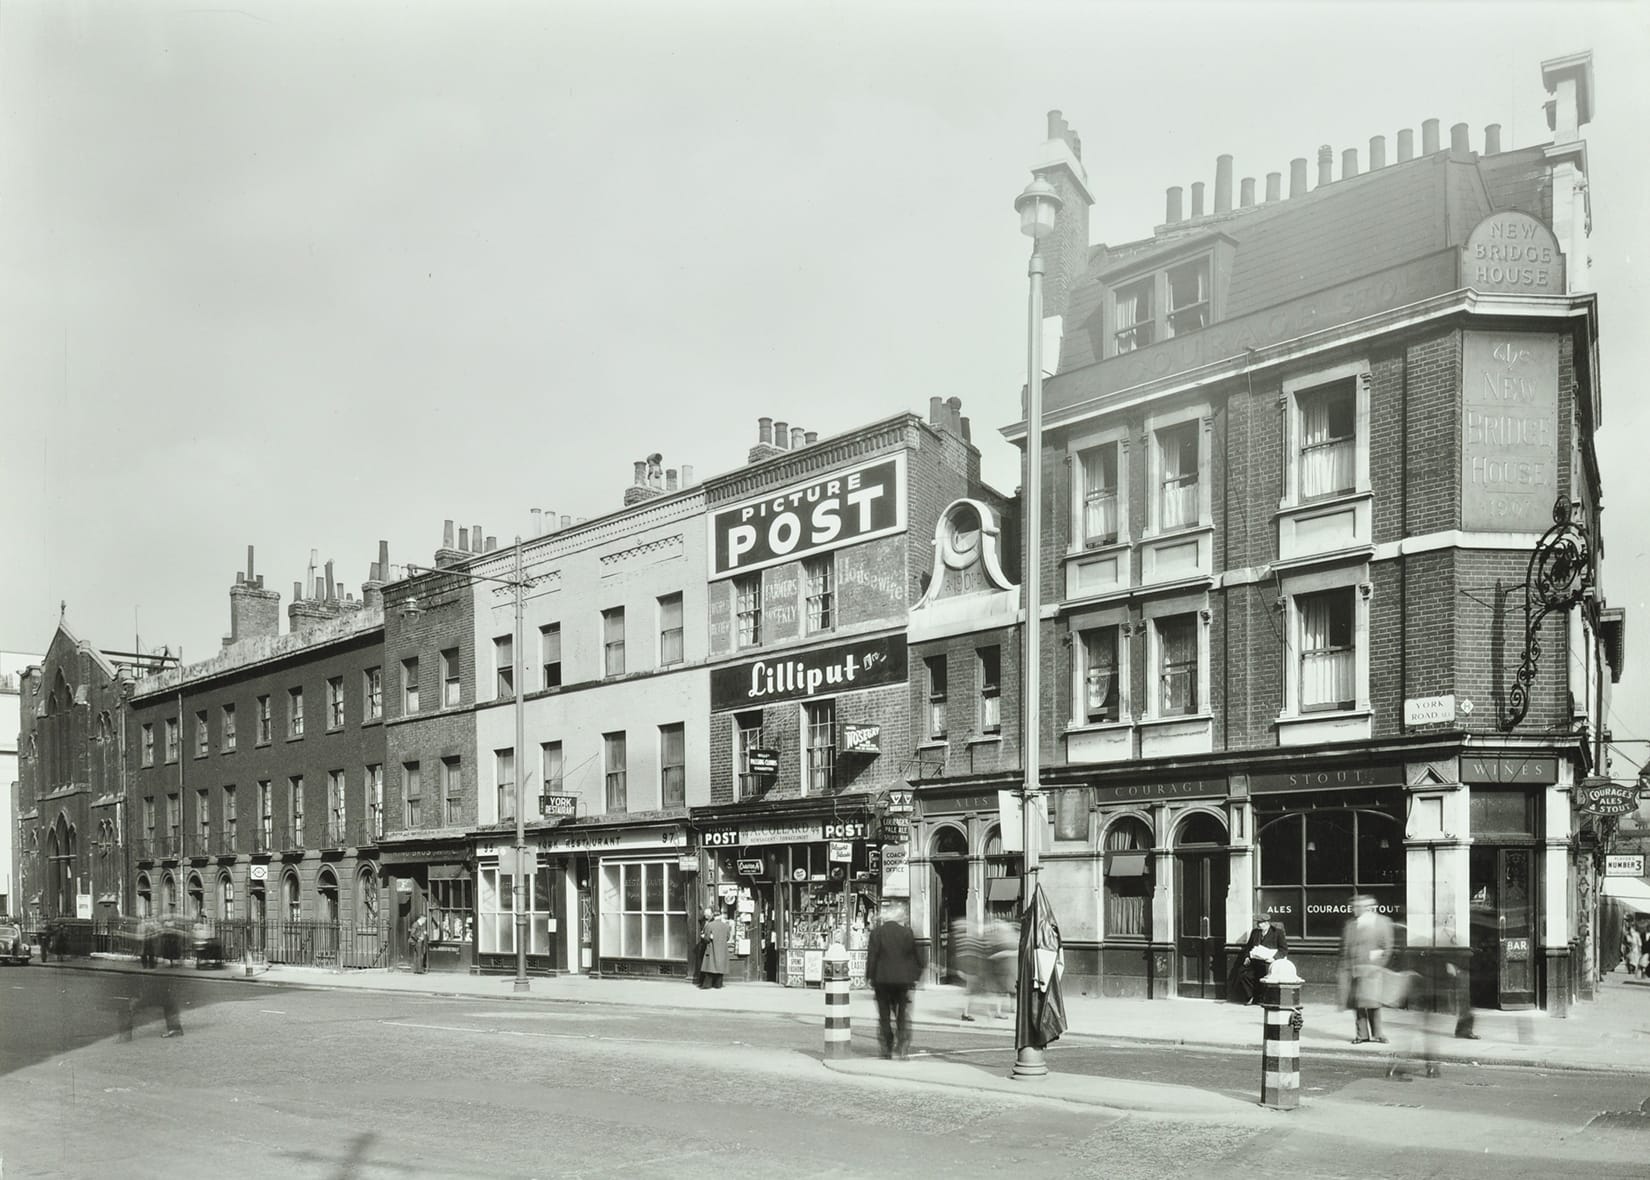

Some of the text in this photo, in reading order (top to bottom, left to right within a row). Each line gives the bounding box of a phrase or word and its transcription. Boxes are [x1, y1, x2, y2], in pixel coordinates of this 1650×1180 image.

[1489, 221, 1538, 240] NEW
[1474, 243, 1553, 264] BRIDGE
[1475, 265, 1549, 287] HOUSE
[1481, 369, 1537, 402] NEW
[1467, 408, 1553, 448] BRIDGE
[1472, 456, 1547, 488] HOUSE
[742, 472, 861, 522] PICTURE
[728, 484, 884, 569] POST
[748, 654, 860, 697] Lilliput
[1415, 700, 1445, 709] YORK
[1411, 711, 1438, 721] ROAD
[1472, 763, 1544, 776] WINES
[1288, 771, 1363, 786] STOUT
[1114, 780, 1207, 797] COURAGE
[550, 797, 572, 806] YORK
[952, 797, 989, 809] ALES
[1589, 803, 1631, 813] & STOUT
[1599, 797, 1623, 805] ALES
[545, 805, 575, 815] RESTAURANT
[705, 831, 737, 845] POST
[825, 823, 864, 838] POST
[566, 836, 621, 848] RESTAURANT
[662, 832, 675, 844] 97
[1608, 860, 1642, 871] NUMBER 3
[1266, 905, 1292, 914] ALES
[1306, 904, 1352, 914] COURAGE
[1506, 940, 1528, 952] BAR
